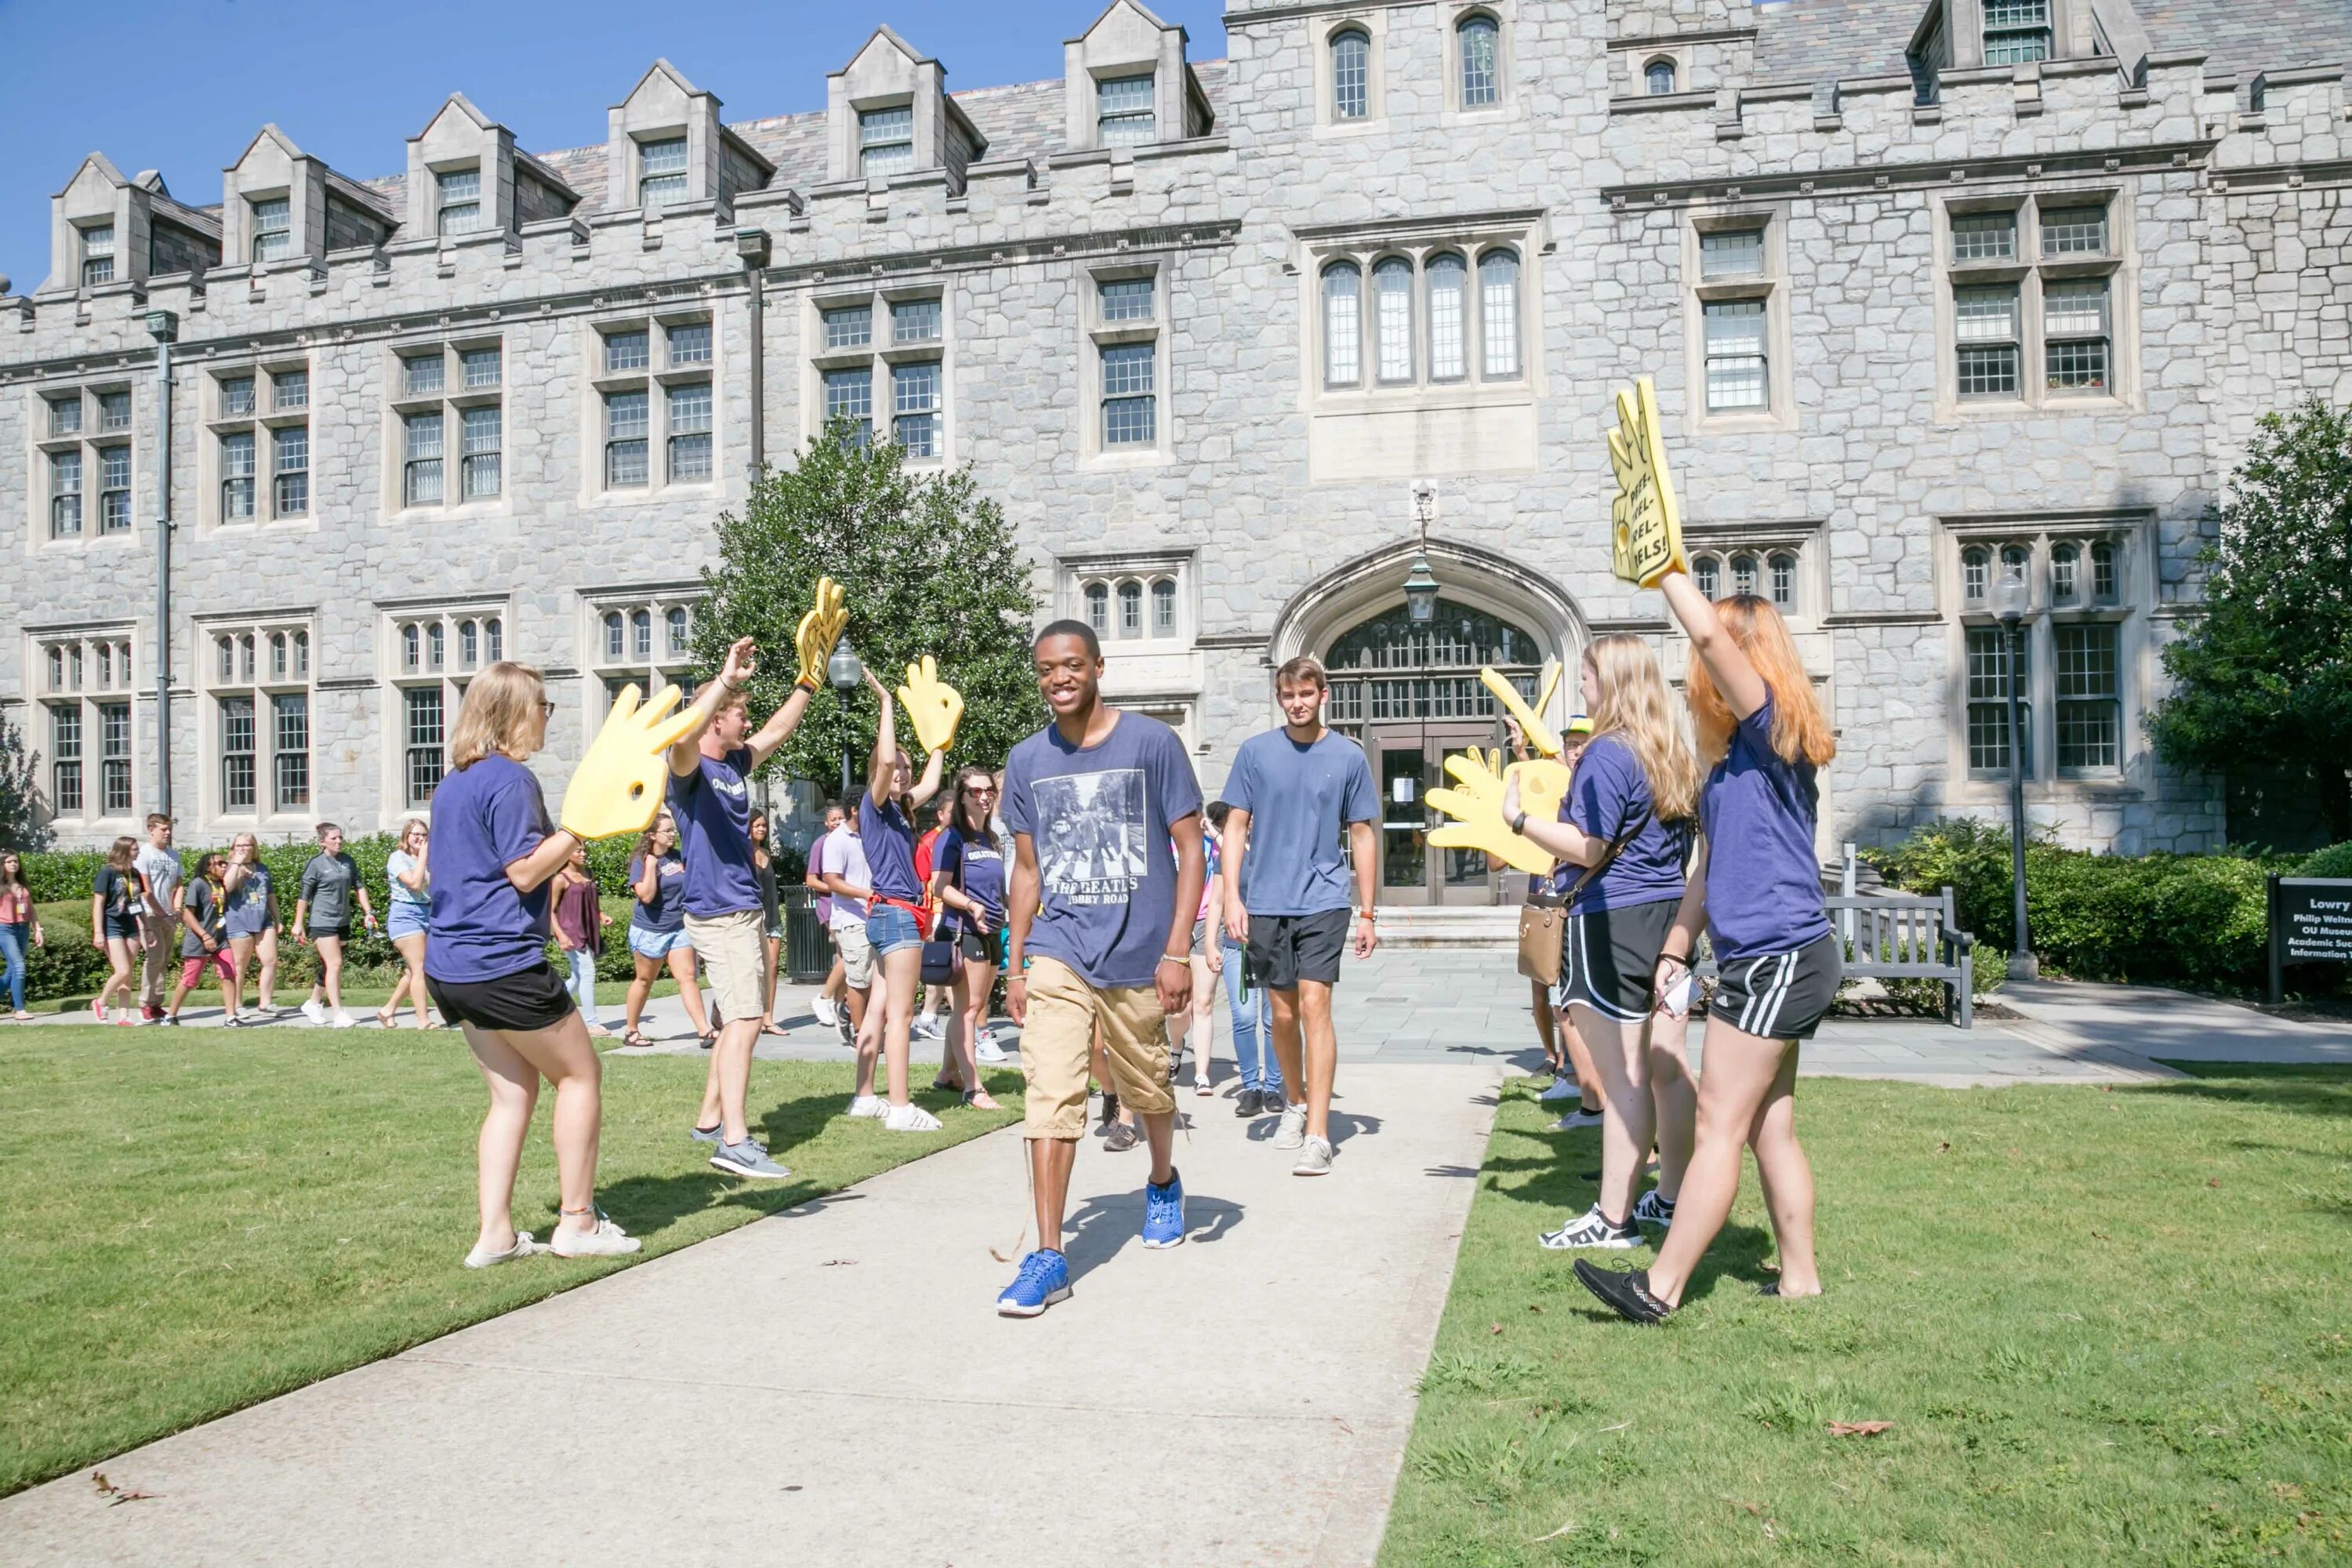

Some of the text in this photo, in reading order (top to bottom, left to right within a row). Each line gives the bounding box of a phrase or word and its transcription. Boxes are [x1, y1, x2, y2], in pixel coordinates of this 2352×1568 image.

[1080, 877, 1138, 894] BEATLS
[1103, 893, 1129, 904] ROAD
[2310, 898, 2351, 912] Lowry
[2293, 913, 2322, 924] Philip
[2302, 926, 2318, 935] OU
[2288, 937, 2334, 947] Academic
[2291, 947, 2347, 958] Information
